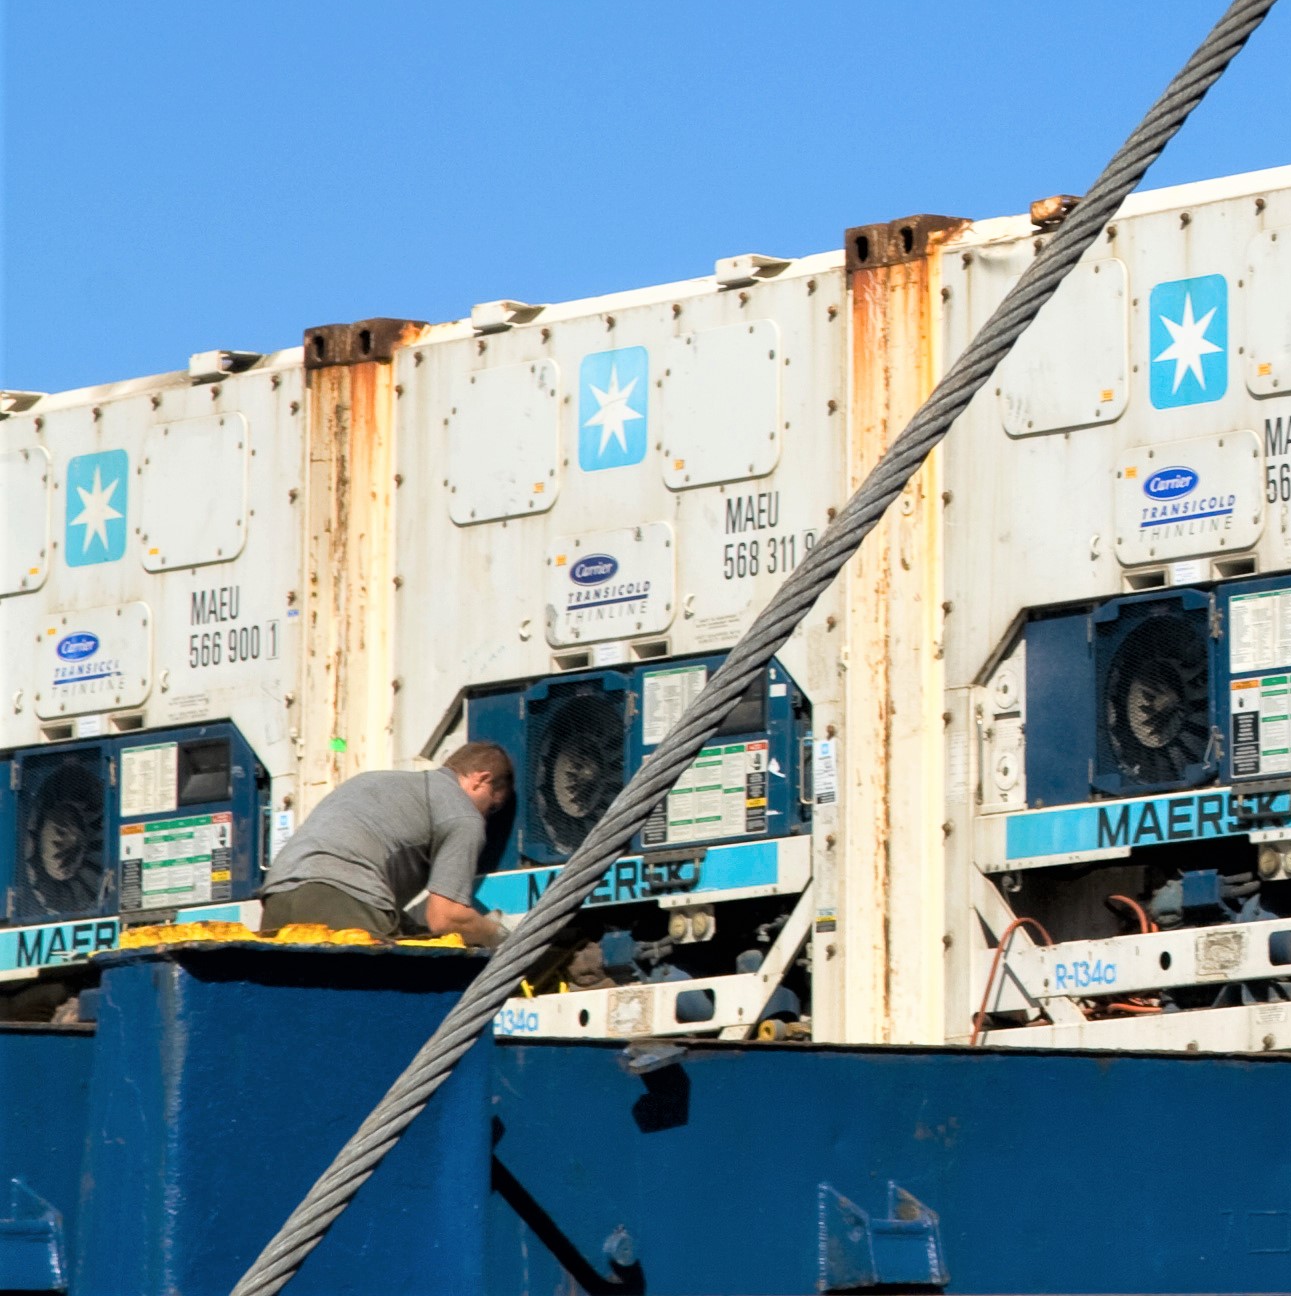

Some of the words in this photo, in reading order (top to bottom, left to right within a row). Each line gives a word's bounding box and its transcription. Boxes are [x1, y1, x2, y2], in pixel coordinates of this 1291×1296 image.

[1149, 473, 1193, 493] Carrier
[725, 491, 779, 535] MAEU
[1142, 494, 1236, 520] TRANSICOLD
[1139, 515, 1233, 543] THINLINE
[574, 563, 614, 579] Carrier
[724, 540, 759, 580] 568
[767, 535, 795, 574] 311
[191, 585, 240, 626] MAEU
[568, 580, 651, 604] TRANSICOLD
[565, 600, 648, 626] THINLINE
[60, 637, 97, 656] Carrier
[189, 631, 222, 669] 566
[228, 625, 261, 663] 900
[17, 921, 117, 968] MAER
[1055, 960, 1118, 991] R-134a
